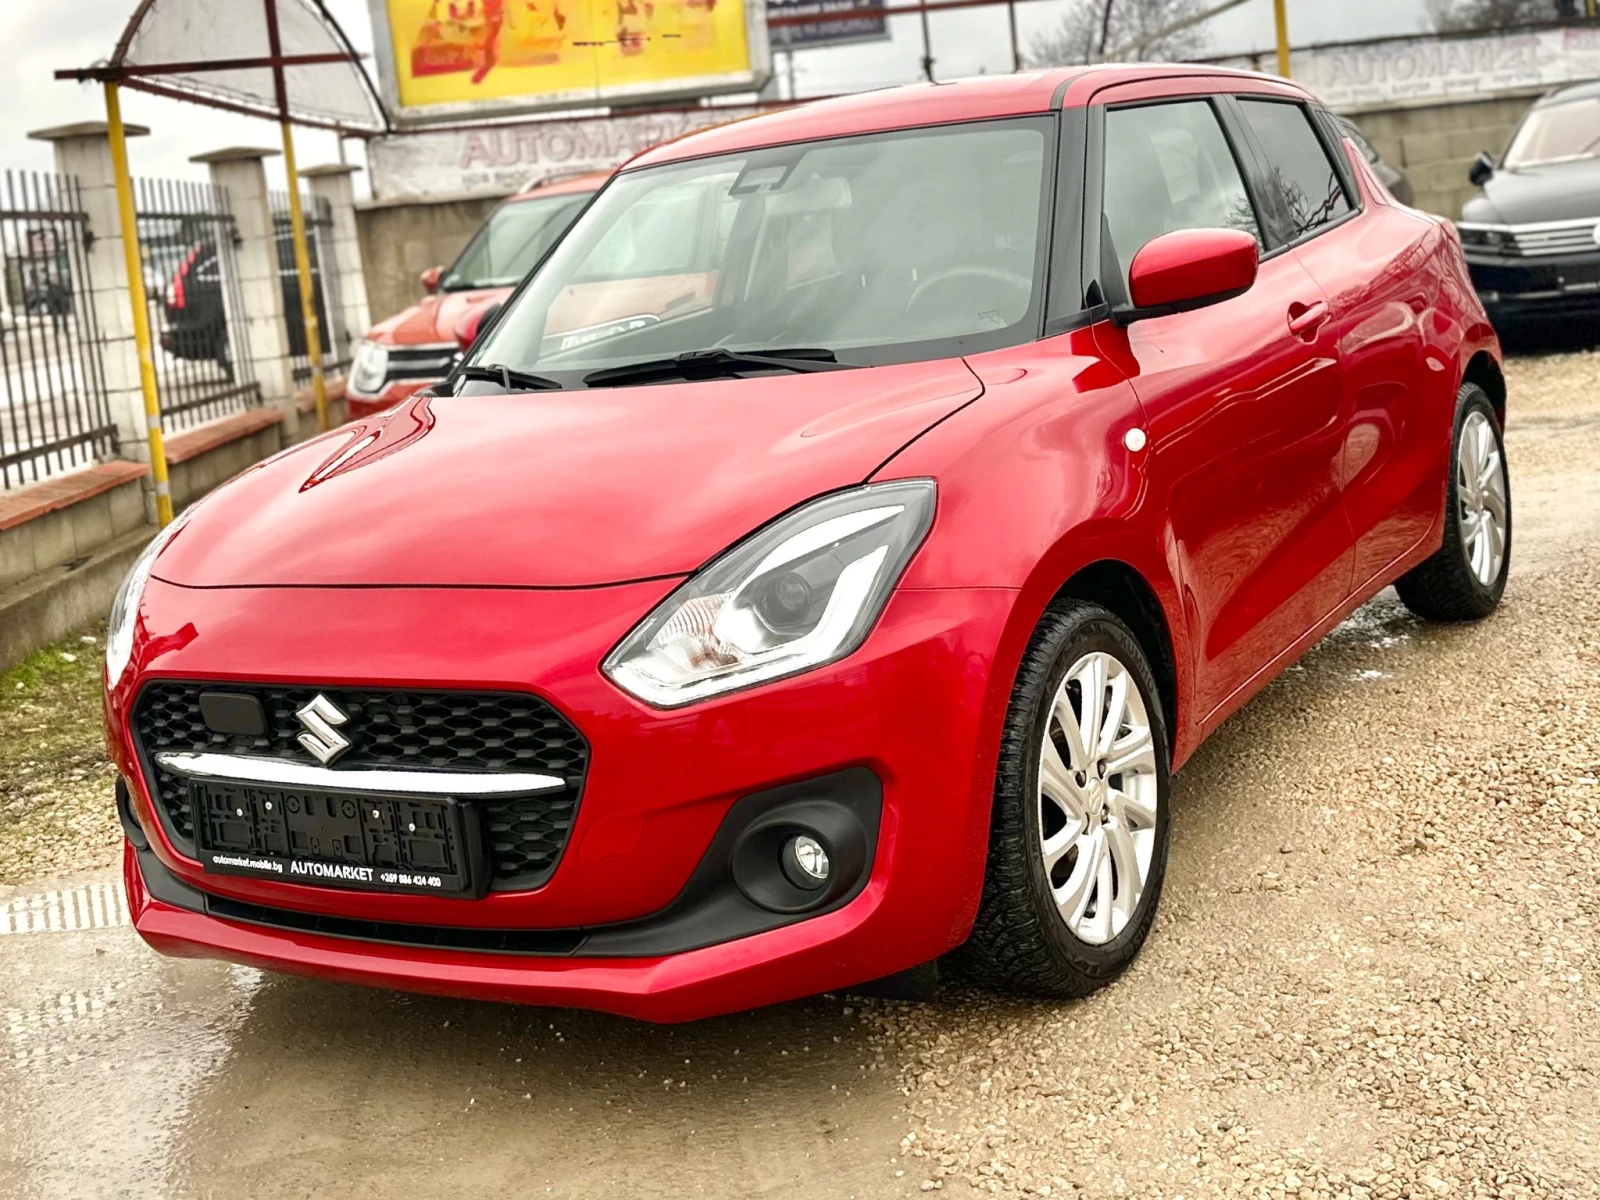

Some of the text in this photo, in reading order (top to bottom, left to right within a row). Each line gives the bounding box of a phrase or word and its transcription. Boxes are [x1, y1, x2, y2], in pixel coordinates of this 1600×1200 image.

[212, 855, 283, 873] automarket.mobile.bg
[290, 860, 374, 881] AUTOMARKET
[380, 872, 398, 884] +359
[413, 875, 427, 886] 424
[427, 876, 442, 887] 400
